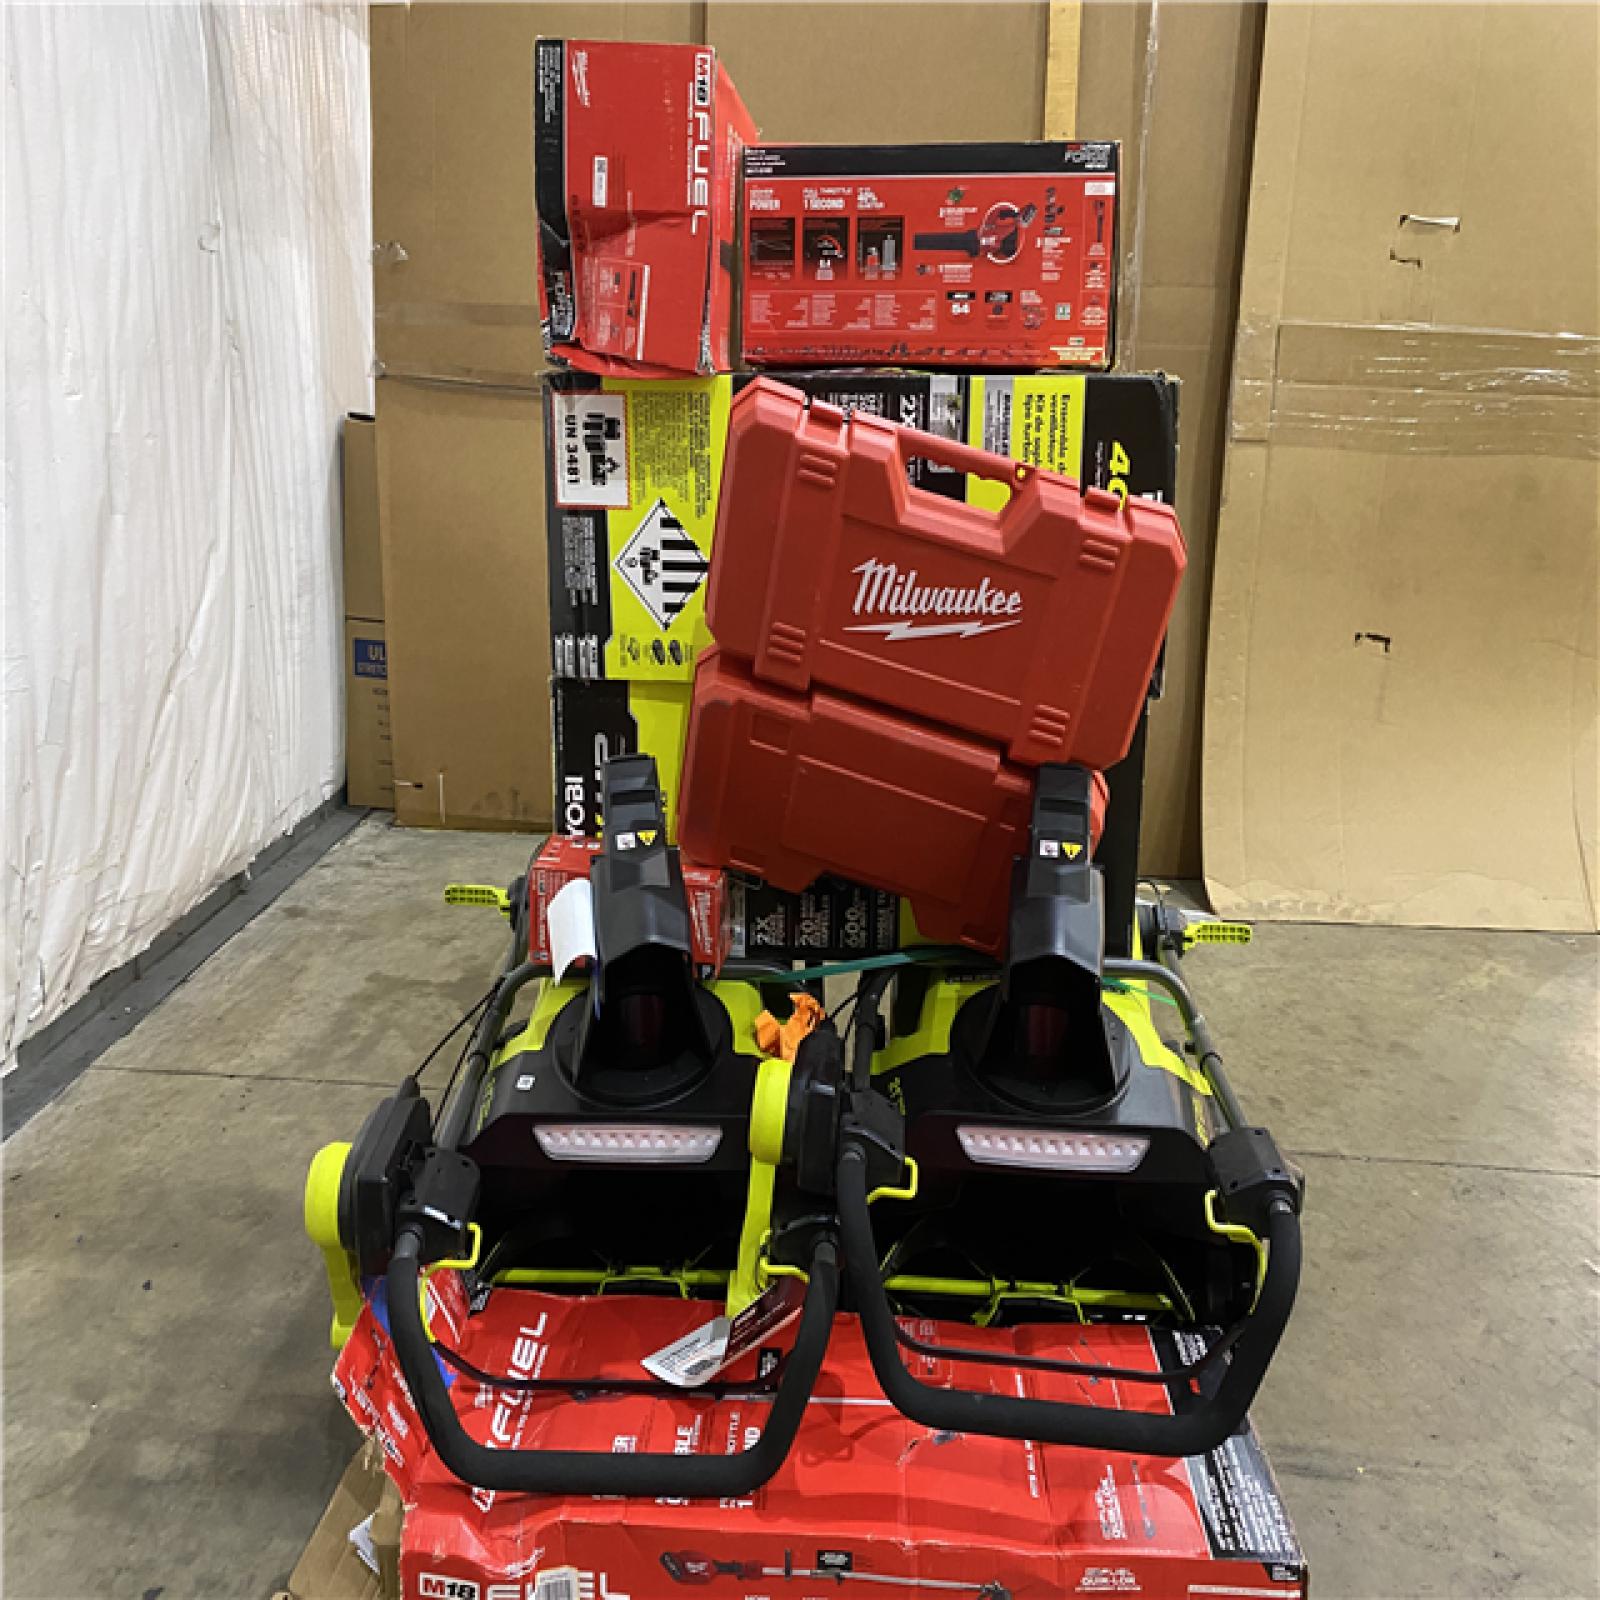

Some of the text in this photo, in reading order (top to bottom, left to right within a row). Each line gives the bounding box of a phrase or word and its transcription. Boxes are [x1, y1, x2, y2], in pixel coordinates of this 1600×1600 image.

[690, 111, 709, 236] FUEL
[564, 413, 581, 484] UN 3481
[851, 556, 1023, 616] Milwaukee
[423, 1571, 631, 1600] M18 FEL
